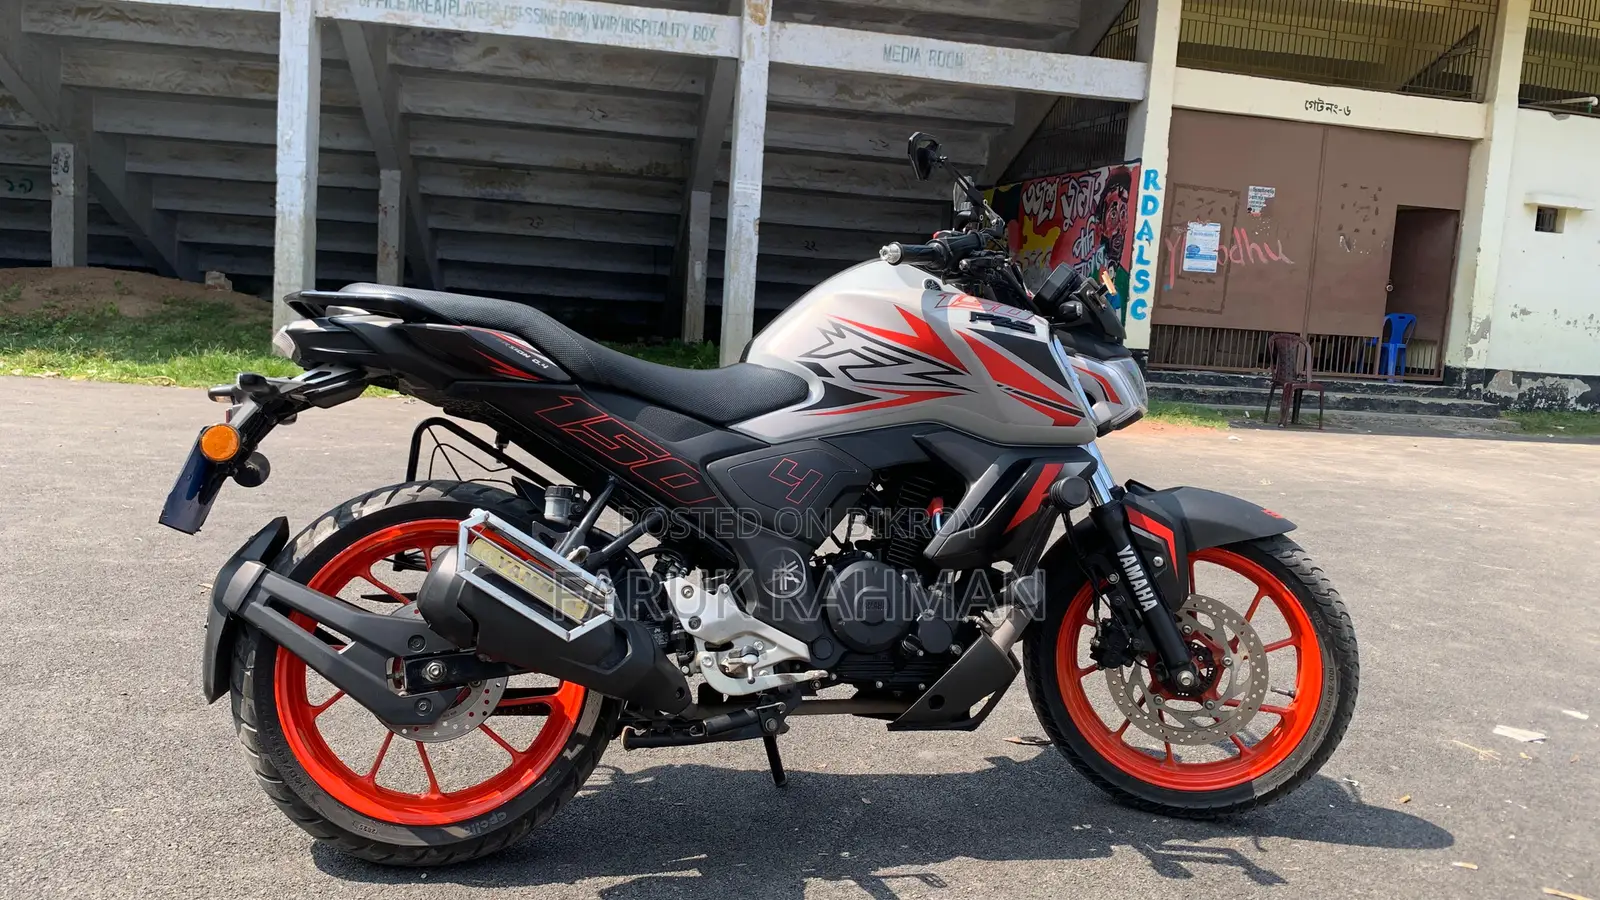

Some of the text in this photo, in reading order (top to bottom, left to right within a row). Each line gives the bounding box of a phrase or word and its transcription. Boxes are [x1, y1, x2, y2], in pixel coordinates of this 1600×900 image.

[883, 43, 921, 65] MEDIA
[534, 394, 718, 505] 150
[1116, 544, 1158, 613] YAMAHA
